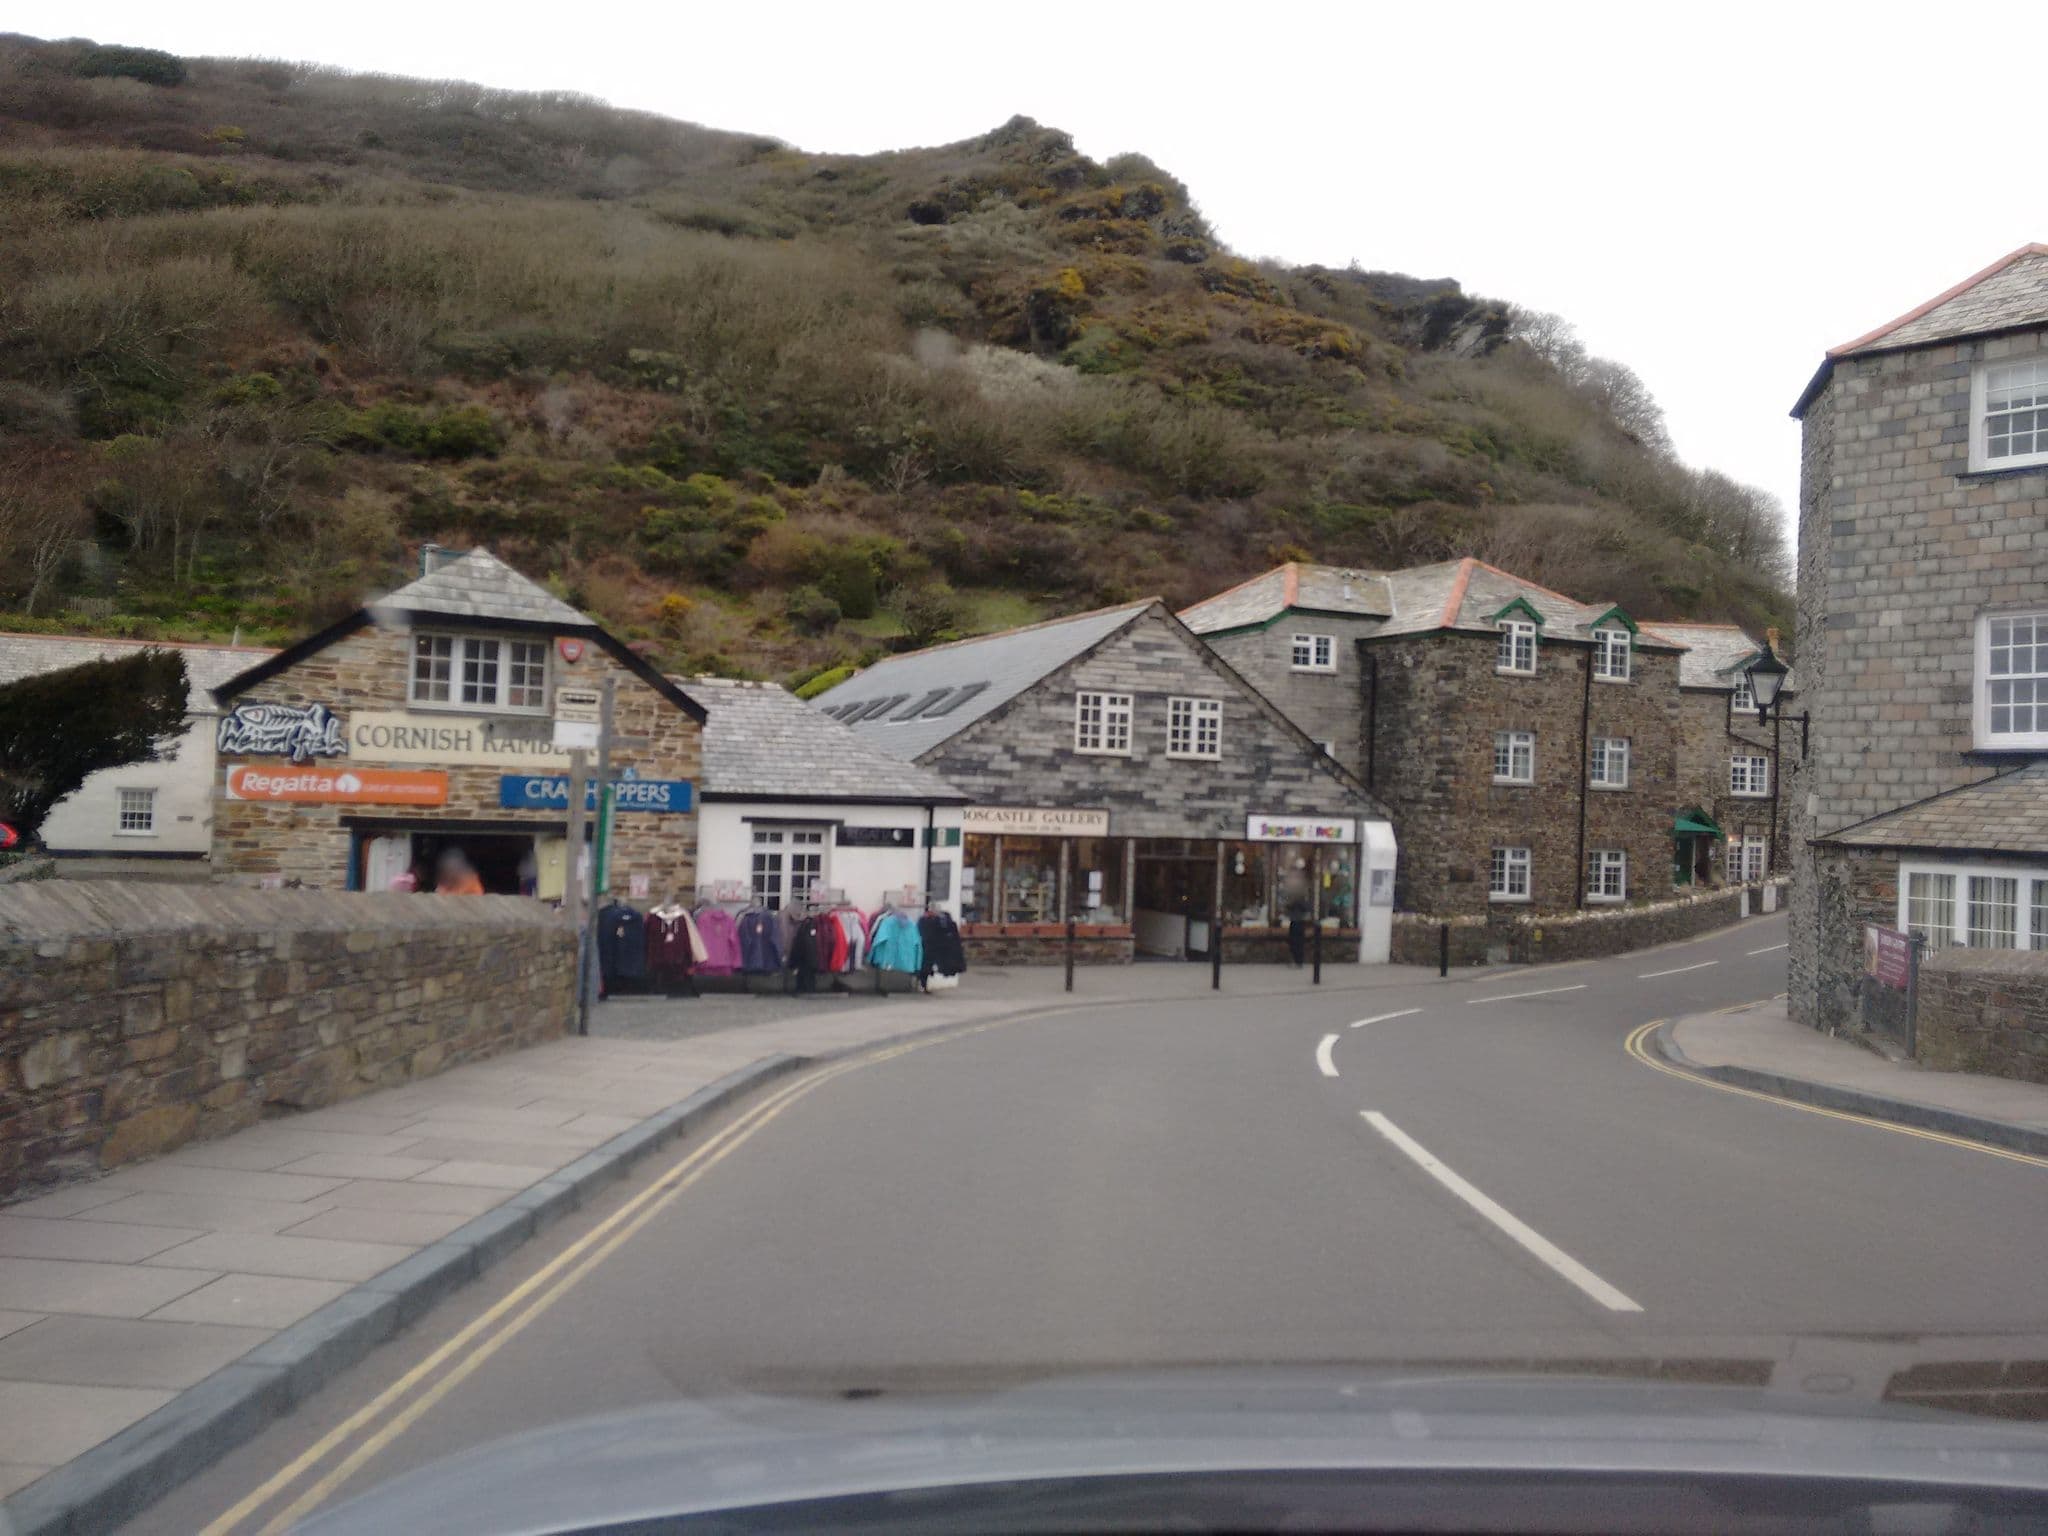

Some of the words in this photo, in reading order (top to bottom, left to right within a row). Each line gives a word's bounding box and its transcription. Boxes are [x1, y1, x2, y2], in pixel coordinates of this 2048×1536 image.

[355, 724, 472, 751] CORNISH
[241, 773, 333, 795] Regatta
[1042, 812, 1103, 825] GALLERY
